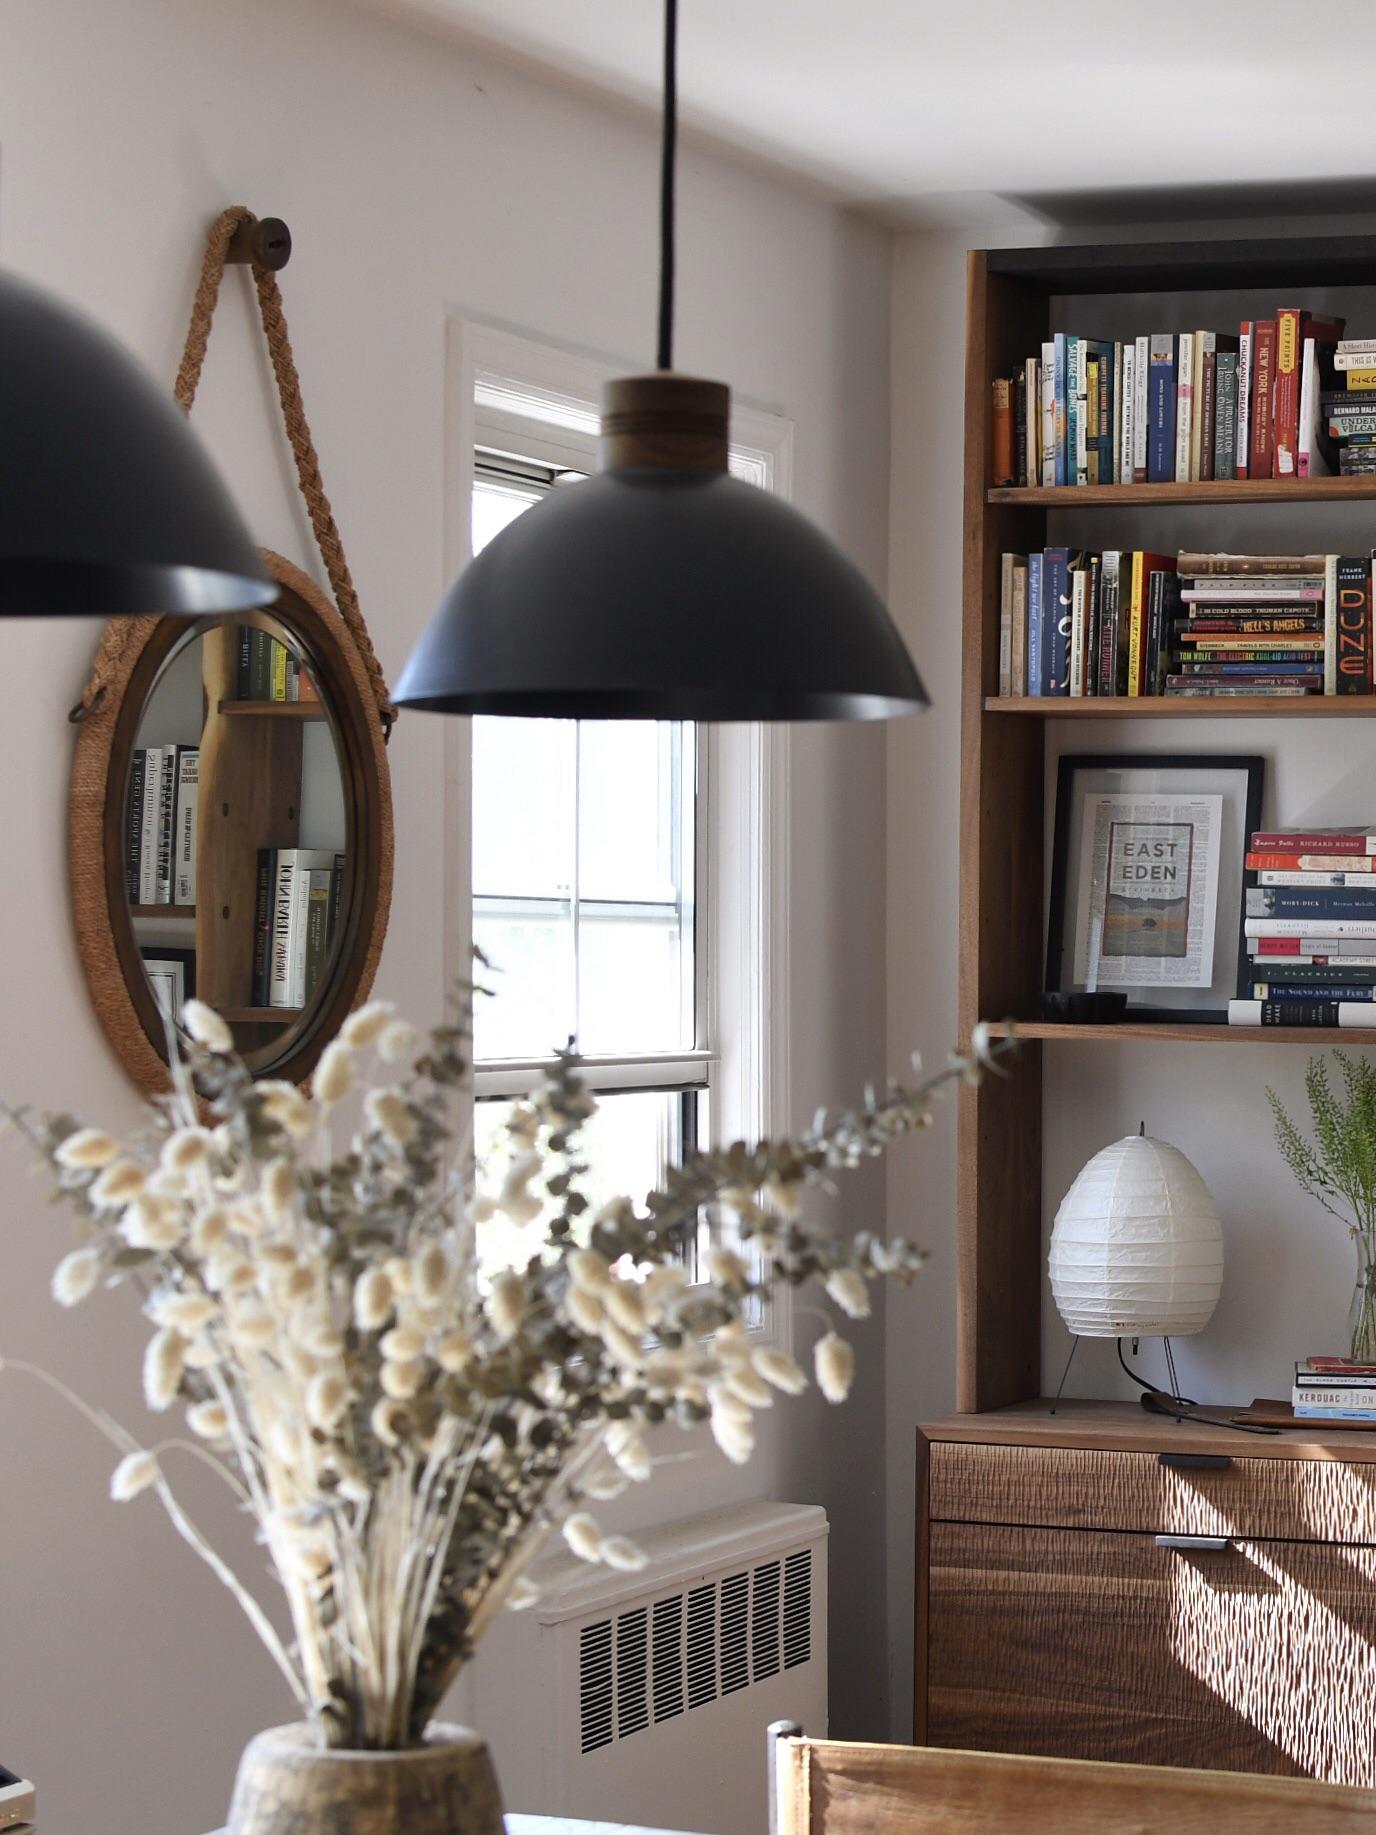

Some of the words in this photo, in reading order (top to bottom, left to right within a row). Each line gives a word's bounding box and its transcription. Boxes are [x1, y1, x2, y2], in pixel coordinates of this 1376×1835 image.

[1068, 344, 1078, 376] SALVAGE
[1239, 340, 1248, 389] CHUCKANUT
[1259, 348, 1269, 367] NEW
[1258, 370, 1269, 394] YORK
[1068, 389, 1078, 413] BONES
[1217, 397, 1225, 424] OWEN
[1239, 391, 1247, 423] DREAMS
[1225, 406, 1233, 435] PRAYER
[1341, 417, 1376, 426] UNDER
[1216, 425, 1225, 455] MEANY
[1243, 621, 1271, 633] HELL'S
[1273, 619, 1305, 631] ANGELS
[1180, 652, 1191, 661] TOM
[1123, 843, 1178, 858] EAST
[1122, 865, 1177, 880] EDEN
[1288, 988, 1309, 997] SOUND
[1299, 1394, 1341, 1403] KEROUAC
